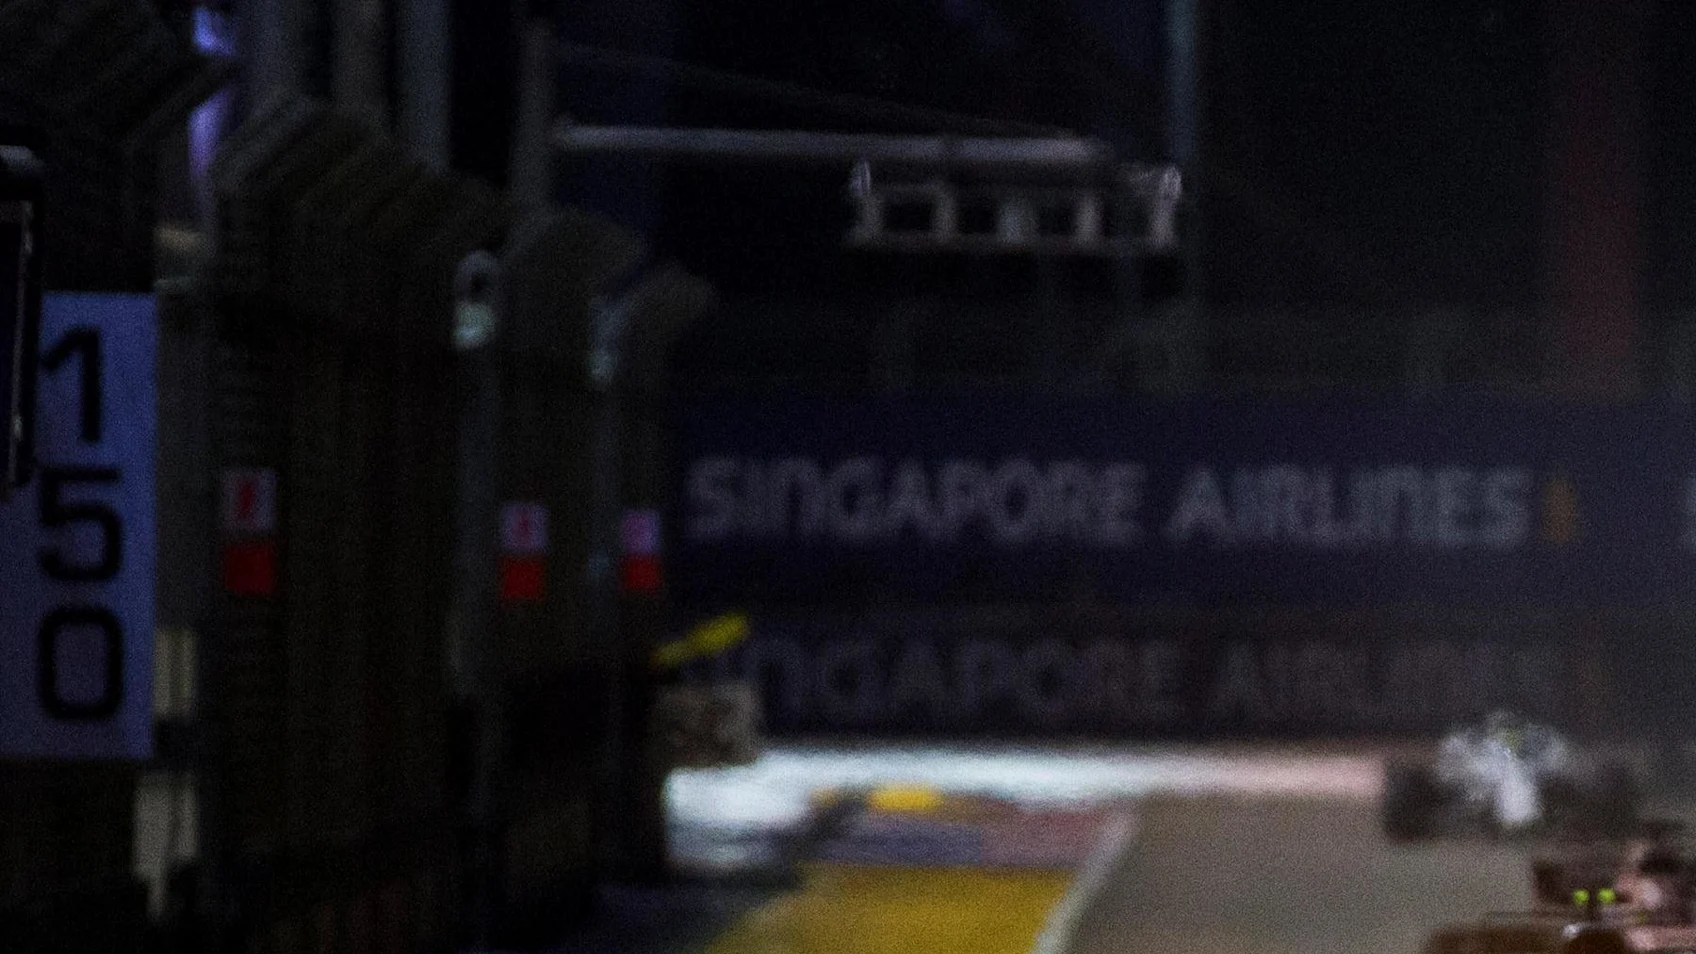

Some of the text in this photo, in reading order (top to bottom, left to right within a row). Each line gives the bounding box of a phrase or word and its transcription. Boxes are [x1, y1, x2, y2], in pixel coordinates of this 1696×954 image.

[40, 326, 121, 721] 150
[684, 456, 1533, 548] SINGAPORE AIRLINES
